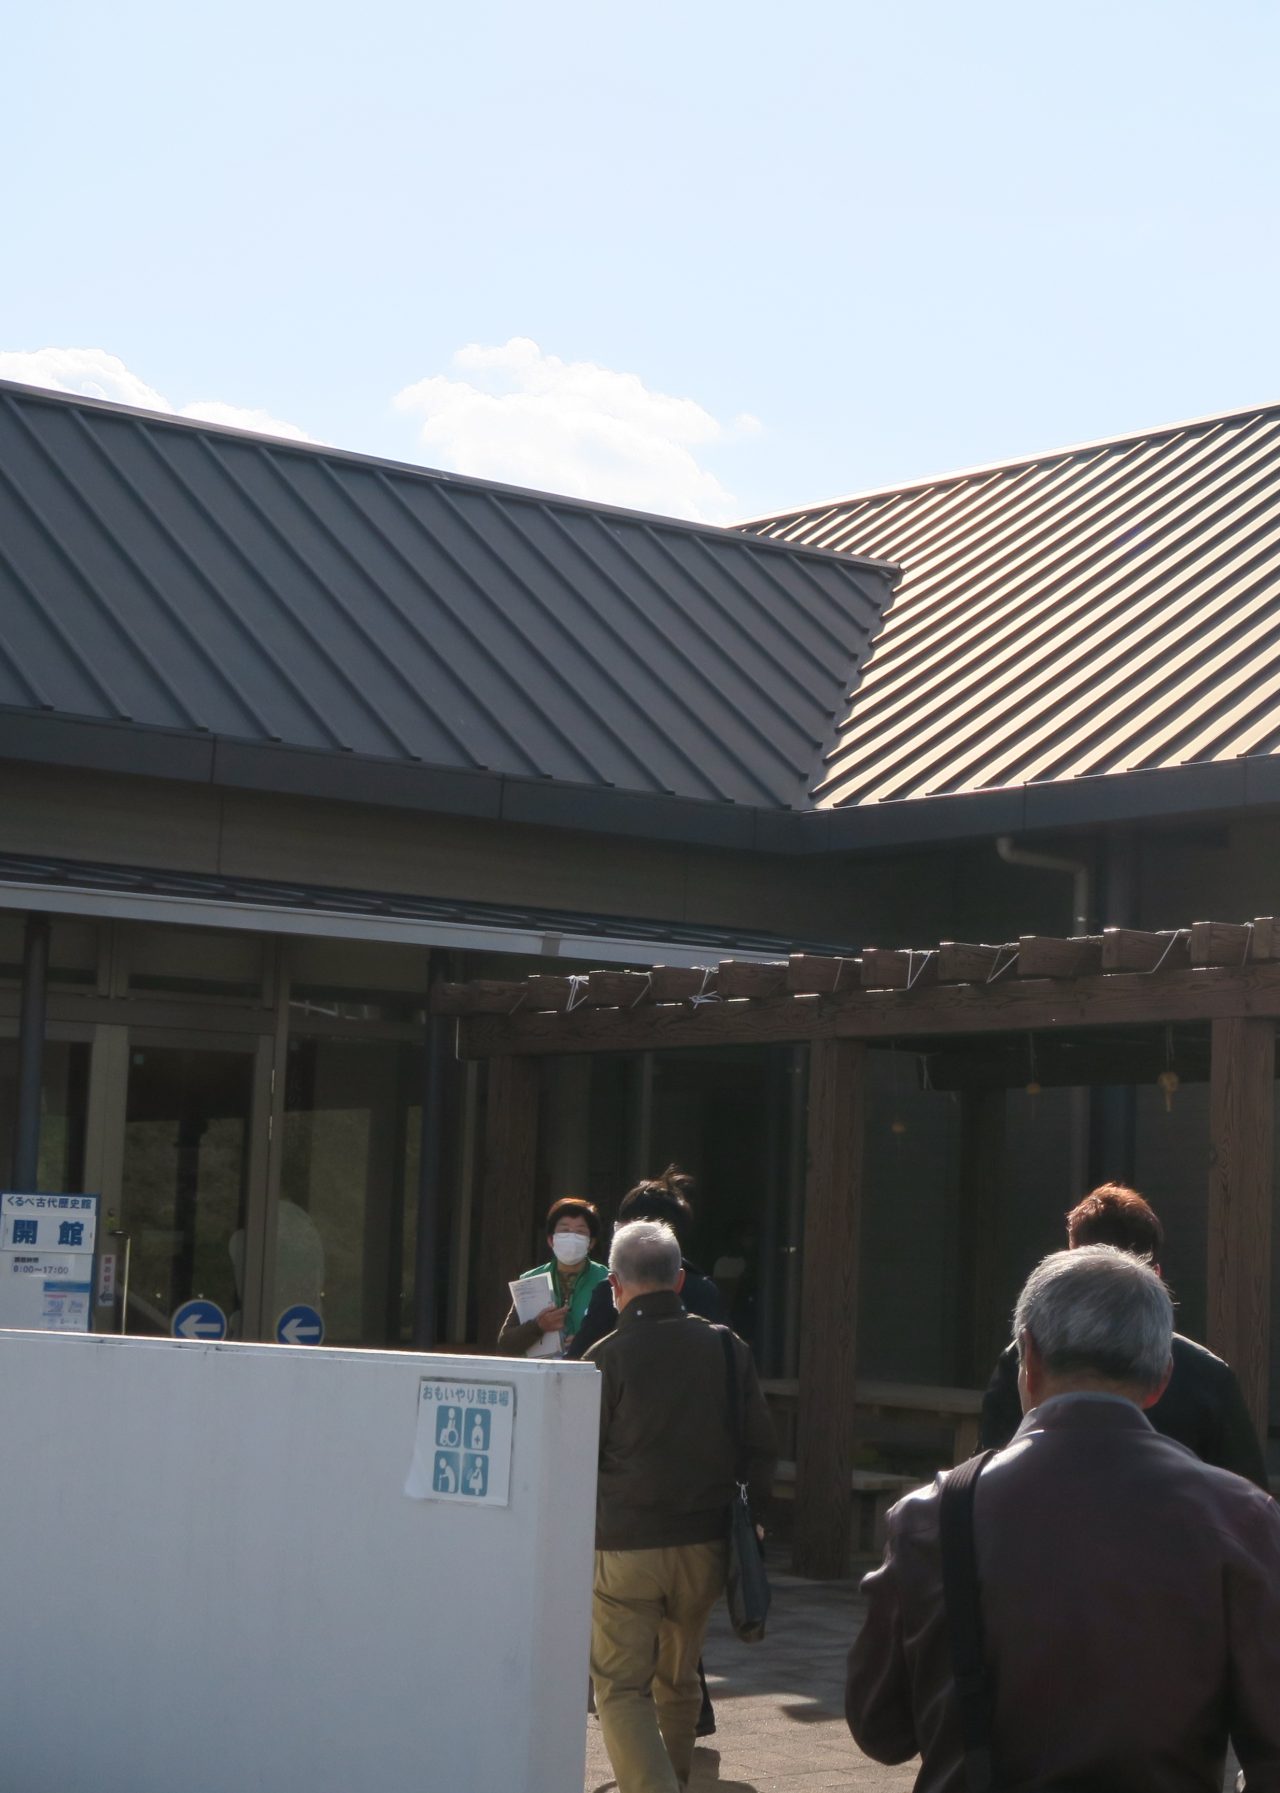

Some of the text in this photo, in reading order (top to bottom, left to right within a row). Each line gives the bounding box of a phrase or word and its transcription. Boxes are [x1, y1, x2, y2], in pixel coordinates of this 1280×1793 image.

[7, 1196, 92, 1210] くるべ古代歴史館
[12, 1219, 84, 1246] 開館
[423, 1385, 509, 1407] おもいやり駐車場
